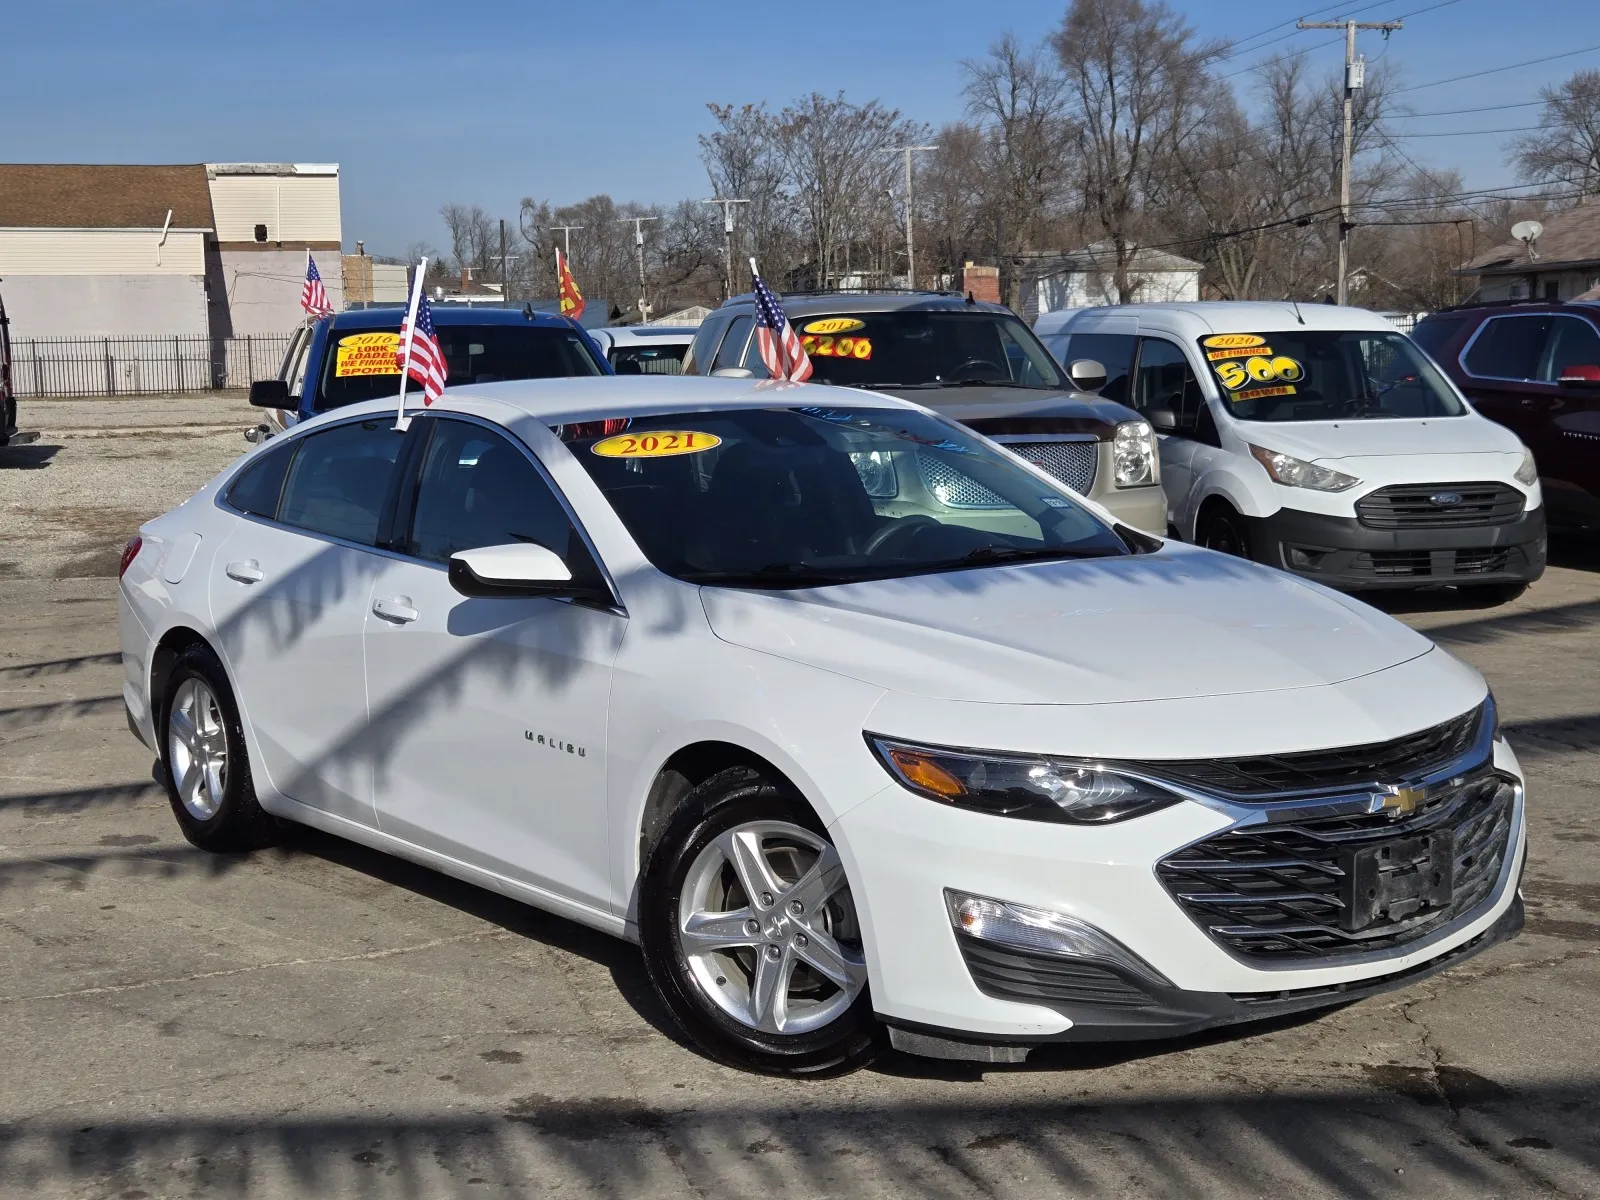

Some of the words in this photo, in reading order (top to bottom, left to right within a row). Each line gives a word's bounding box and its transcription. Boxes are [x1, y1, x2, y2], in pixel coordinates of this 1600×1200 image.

[817, 321, 855, 331] 2013
[350, 336, 393, 345] 2016
[1215, 336, 1255, 345] 2020
[357, 345, 389, 353] LOOK
[802, 336, 872, 358] 6200
[1210, 351, 1227, 360] WE
[1227, 348, 1269, 357] FINANCE
[341, 367, 399, 375] SPORTY
[1214, 356, 1305, 390] 500
[1238, 387, 1289, 399] DOWN
[621, 433, 696, 454] 2021
[525, 730, 586, 757] MALIBU
